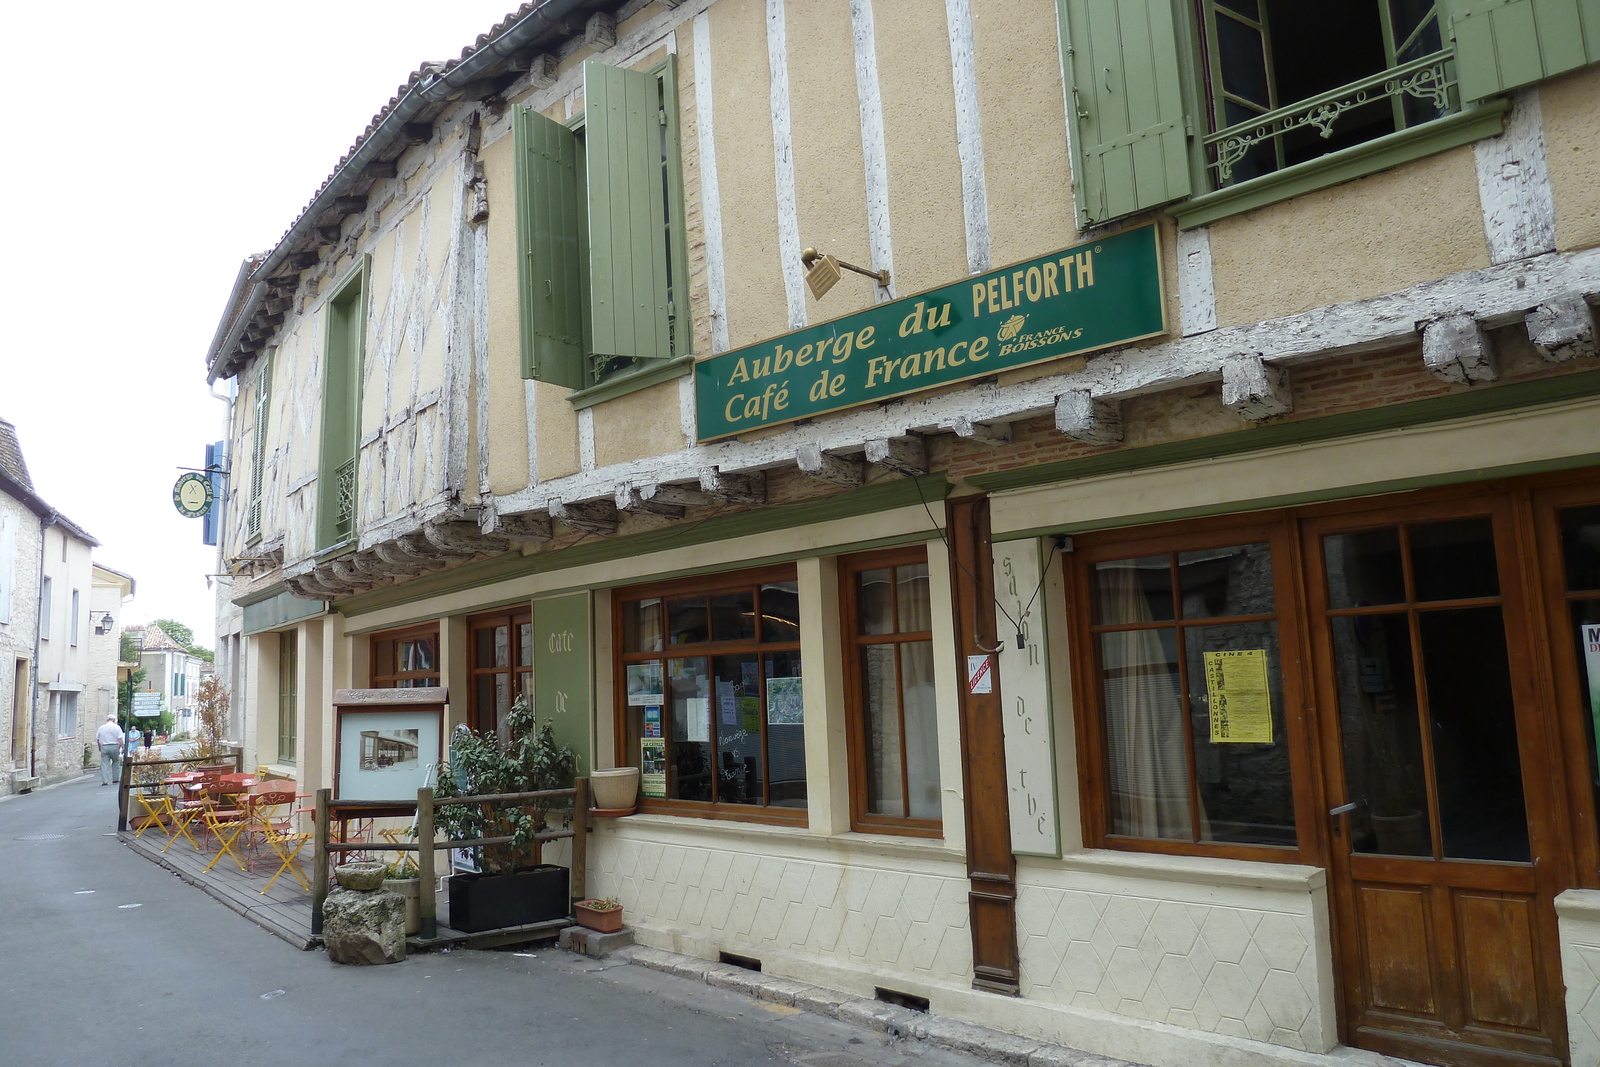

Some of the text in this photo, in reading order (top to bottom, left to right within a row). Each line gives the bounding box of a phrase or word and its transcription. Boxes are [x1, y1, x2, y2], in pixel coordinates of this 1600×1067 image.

[972, 250, 1094, 318] PELFORTH
[727, 301, 951, 387] Auberge du
[999, 328, 1083, 356] BOISSONS
[1019, 326, 1066, 342] FRANCE
[725, 334, 989, 422] Café de France
[970, 659, 989, 690] LICENCE
[1208, 661, 1219, 736] CASTILLONNES
